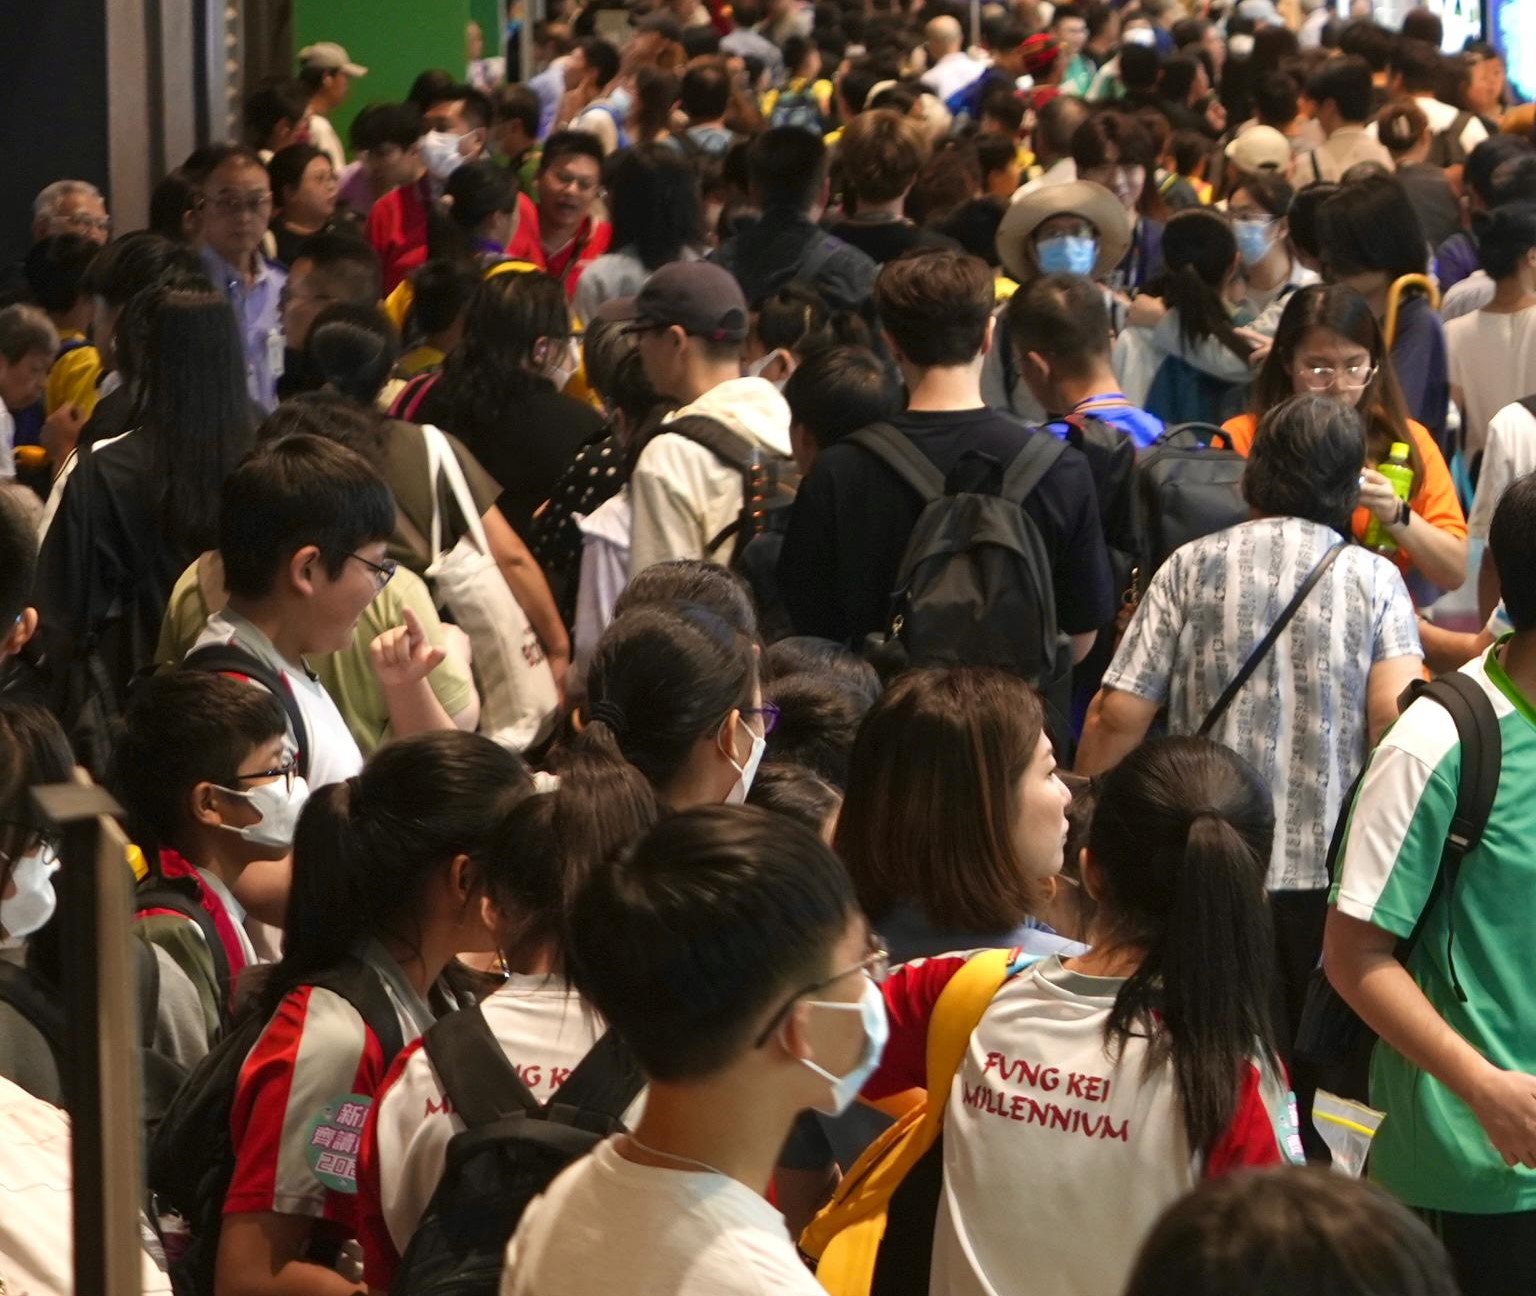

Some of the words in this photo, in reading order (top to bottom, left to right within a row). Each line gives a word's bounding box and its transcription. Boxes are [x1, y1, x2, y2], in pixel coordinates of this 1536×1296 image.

[982, 1051, 1059, 1092] FUNG
[1067, 1072, 1111, 1103] KEI
[963, 1081, 1130, 1143] MILLENNIUM
[312, 1124, 360, 1155] 齊讀
